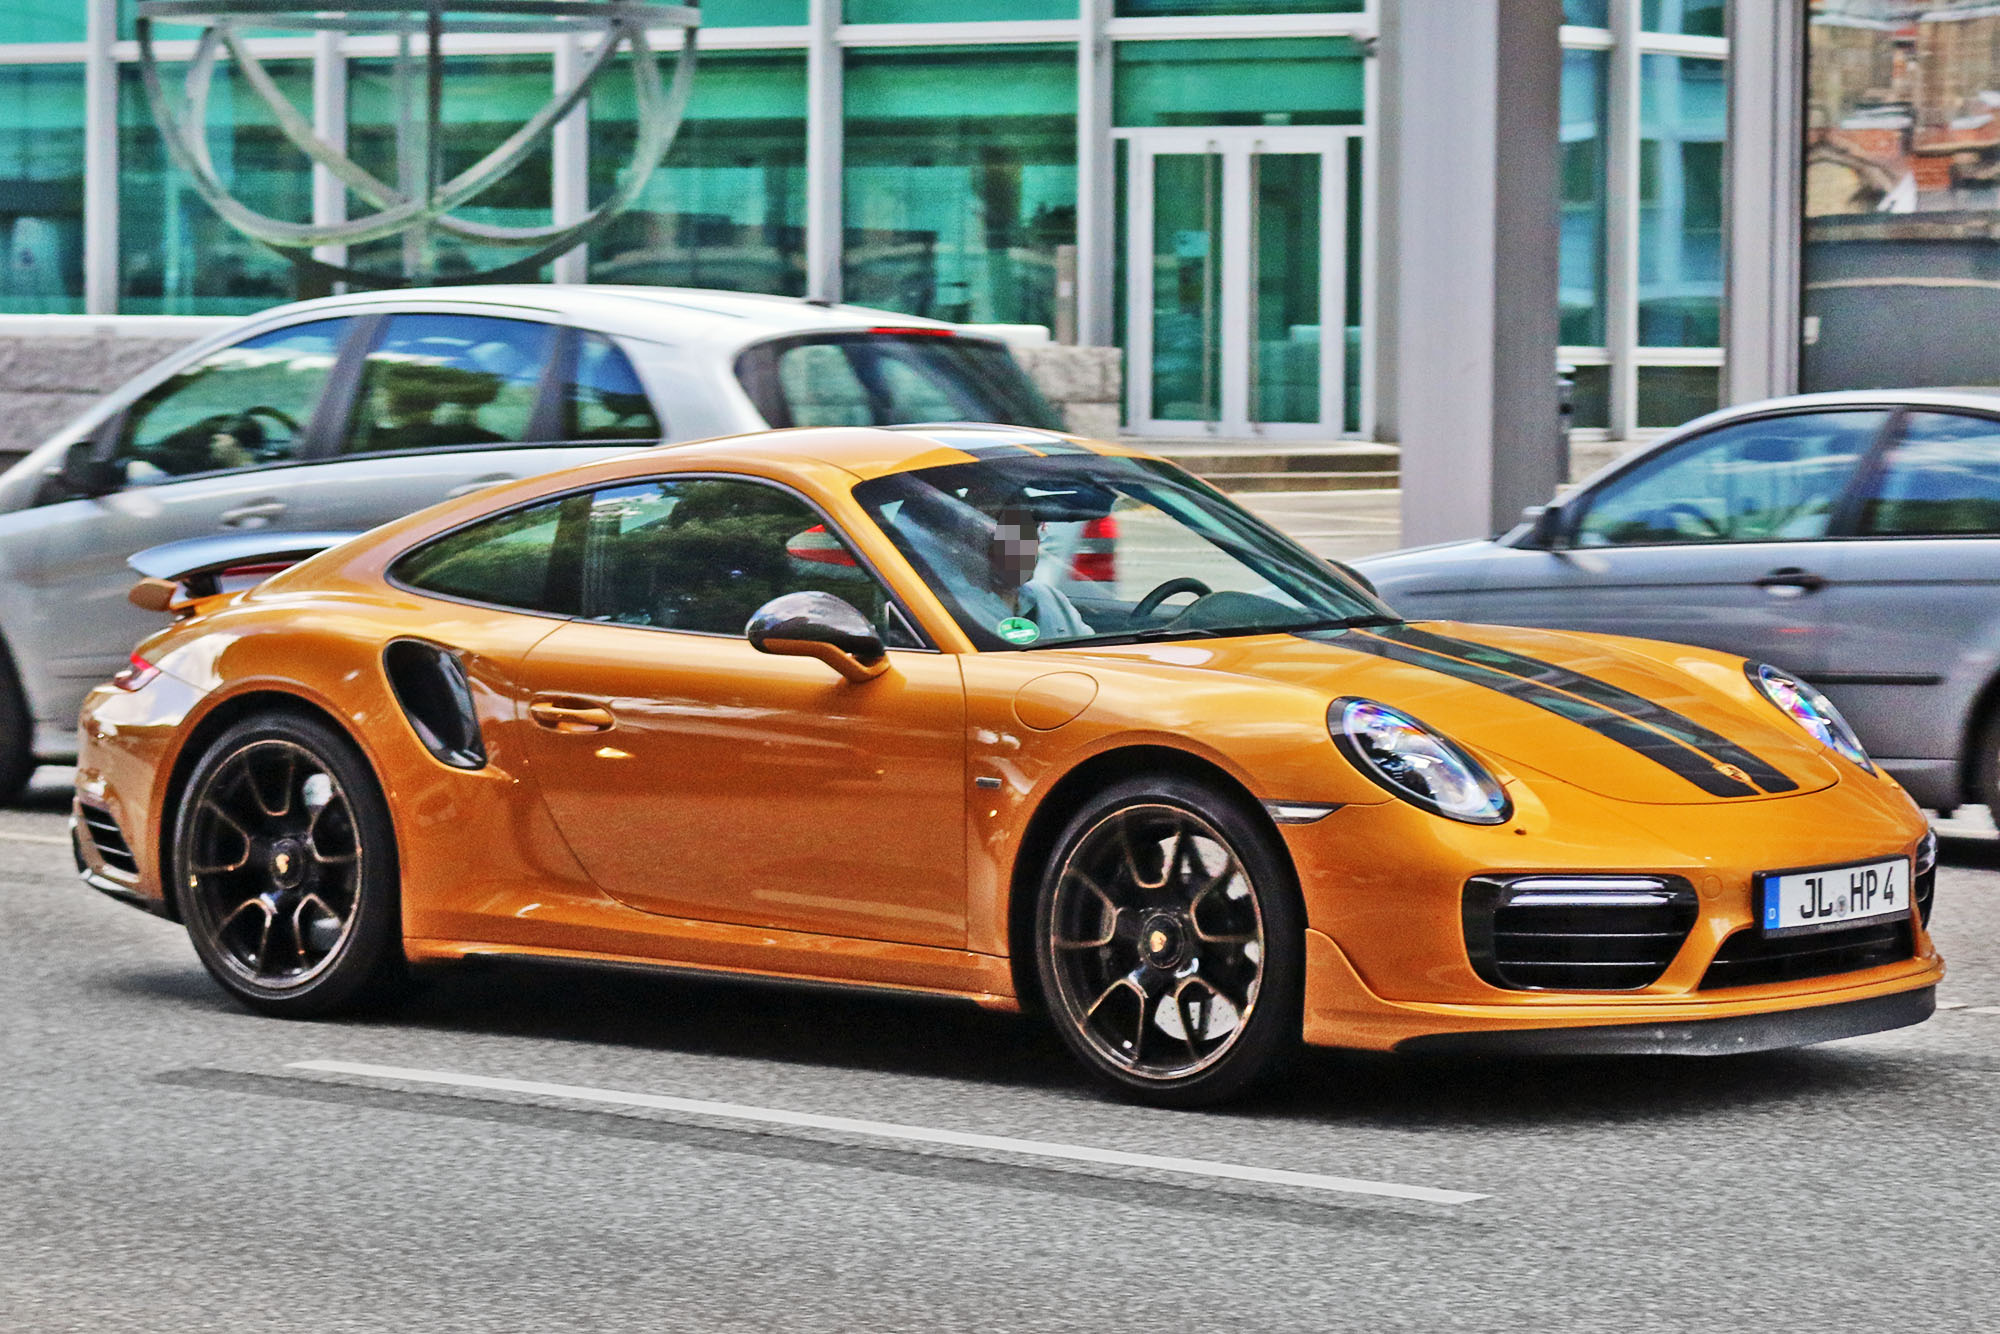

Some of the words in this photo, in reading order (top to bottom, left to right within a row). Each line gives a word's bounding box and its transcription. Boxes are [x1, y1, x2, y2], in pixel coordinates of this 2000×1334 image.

[1800, 877, 1833, 919] JL
[1850, 869, 1878, 913] HP
[1883, 866, 1894, 905] 4
